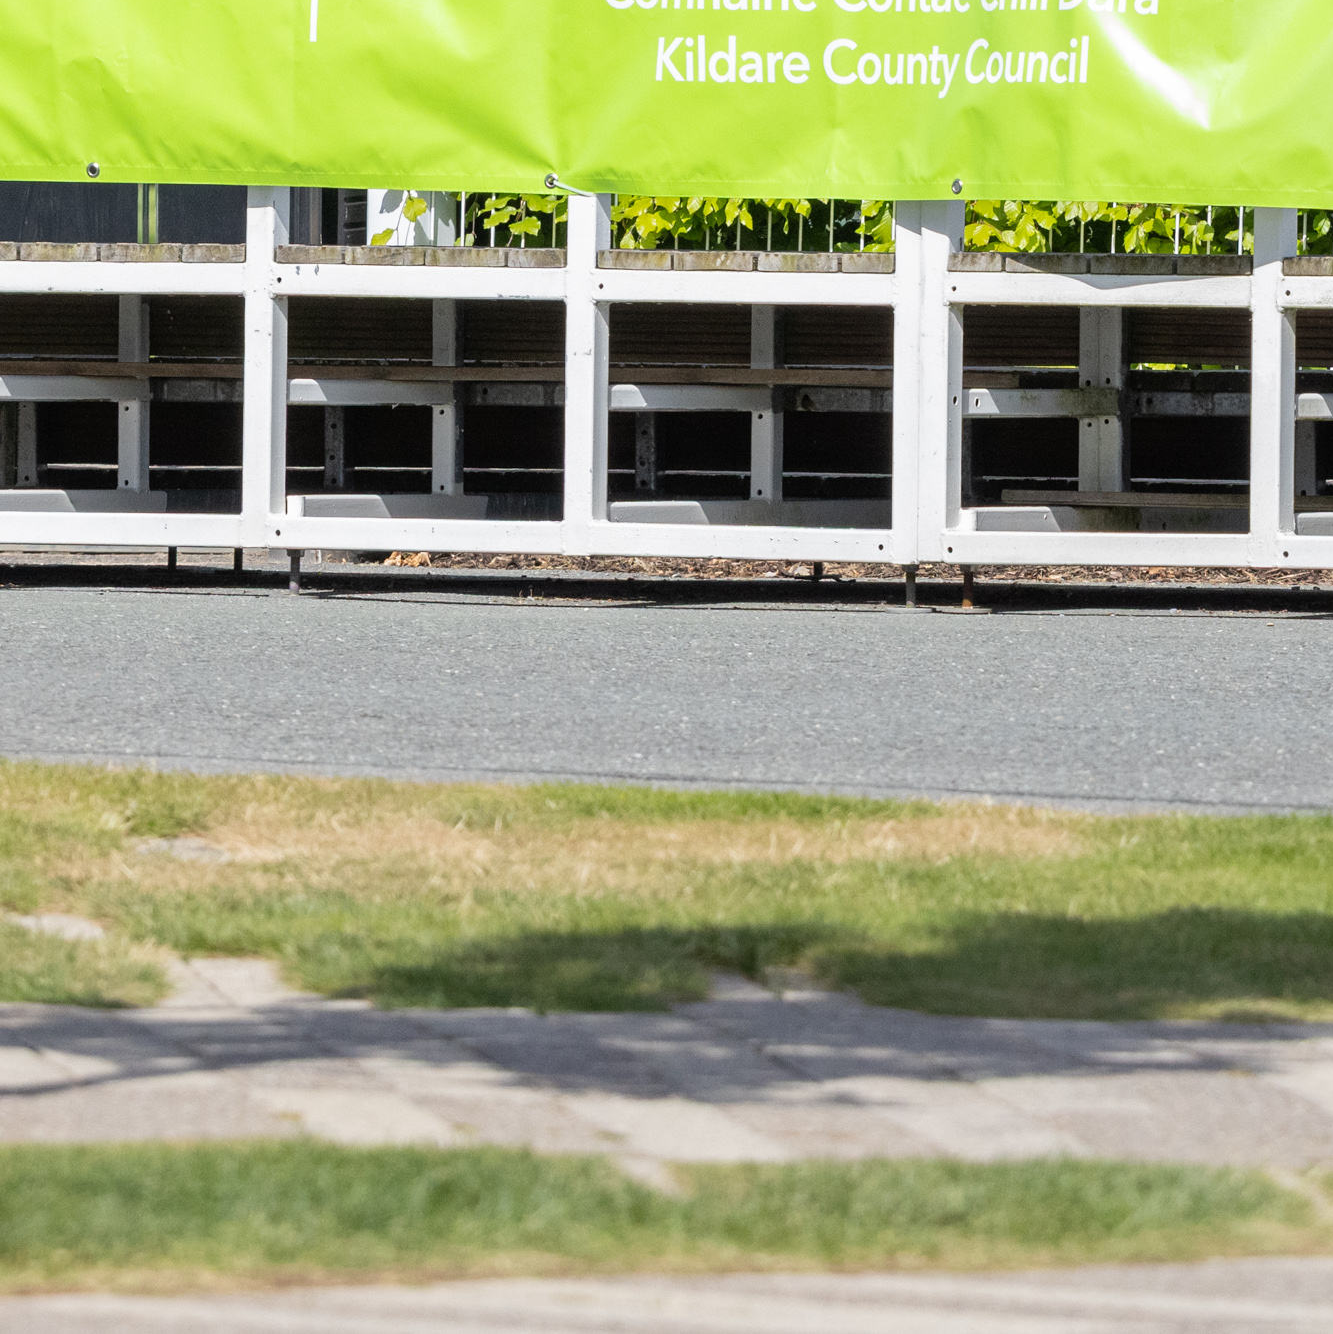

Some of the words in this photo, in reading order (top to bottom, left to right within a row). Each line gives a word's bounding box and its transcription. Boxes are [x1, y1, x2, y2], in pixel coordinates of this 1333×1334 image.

[655, 34, 811, 85] Kildare
[822, 38, 961, 100] County
[964, 35, 1090, 85] Council
